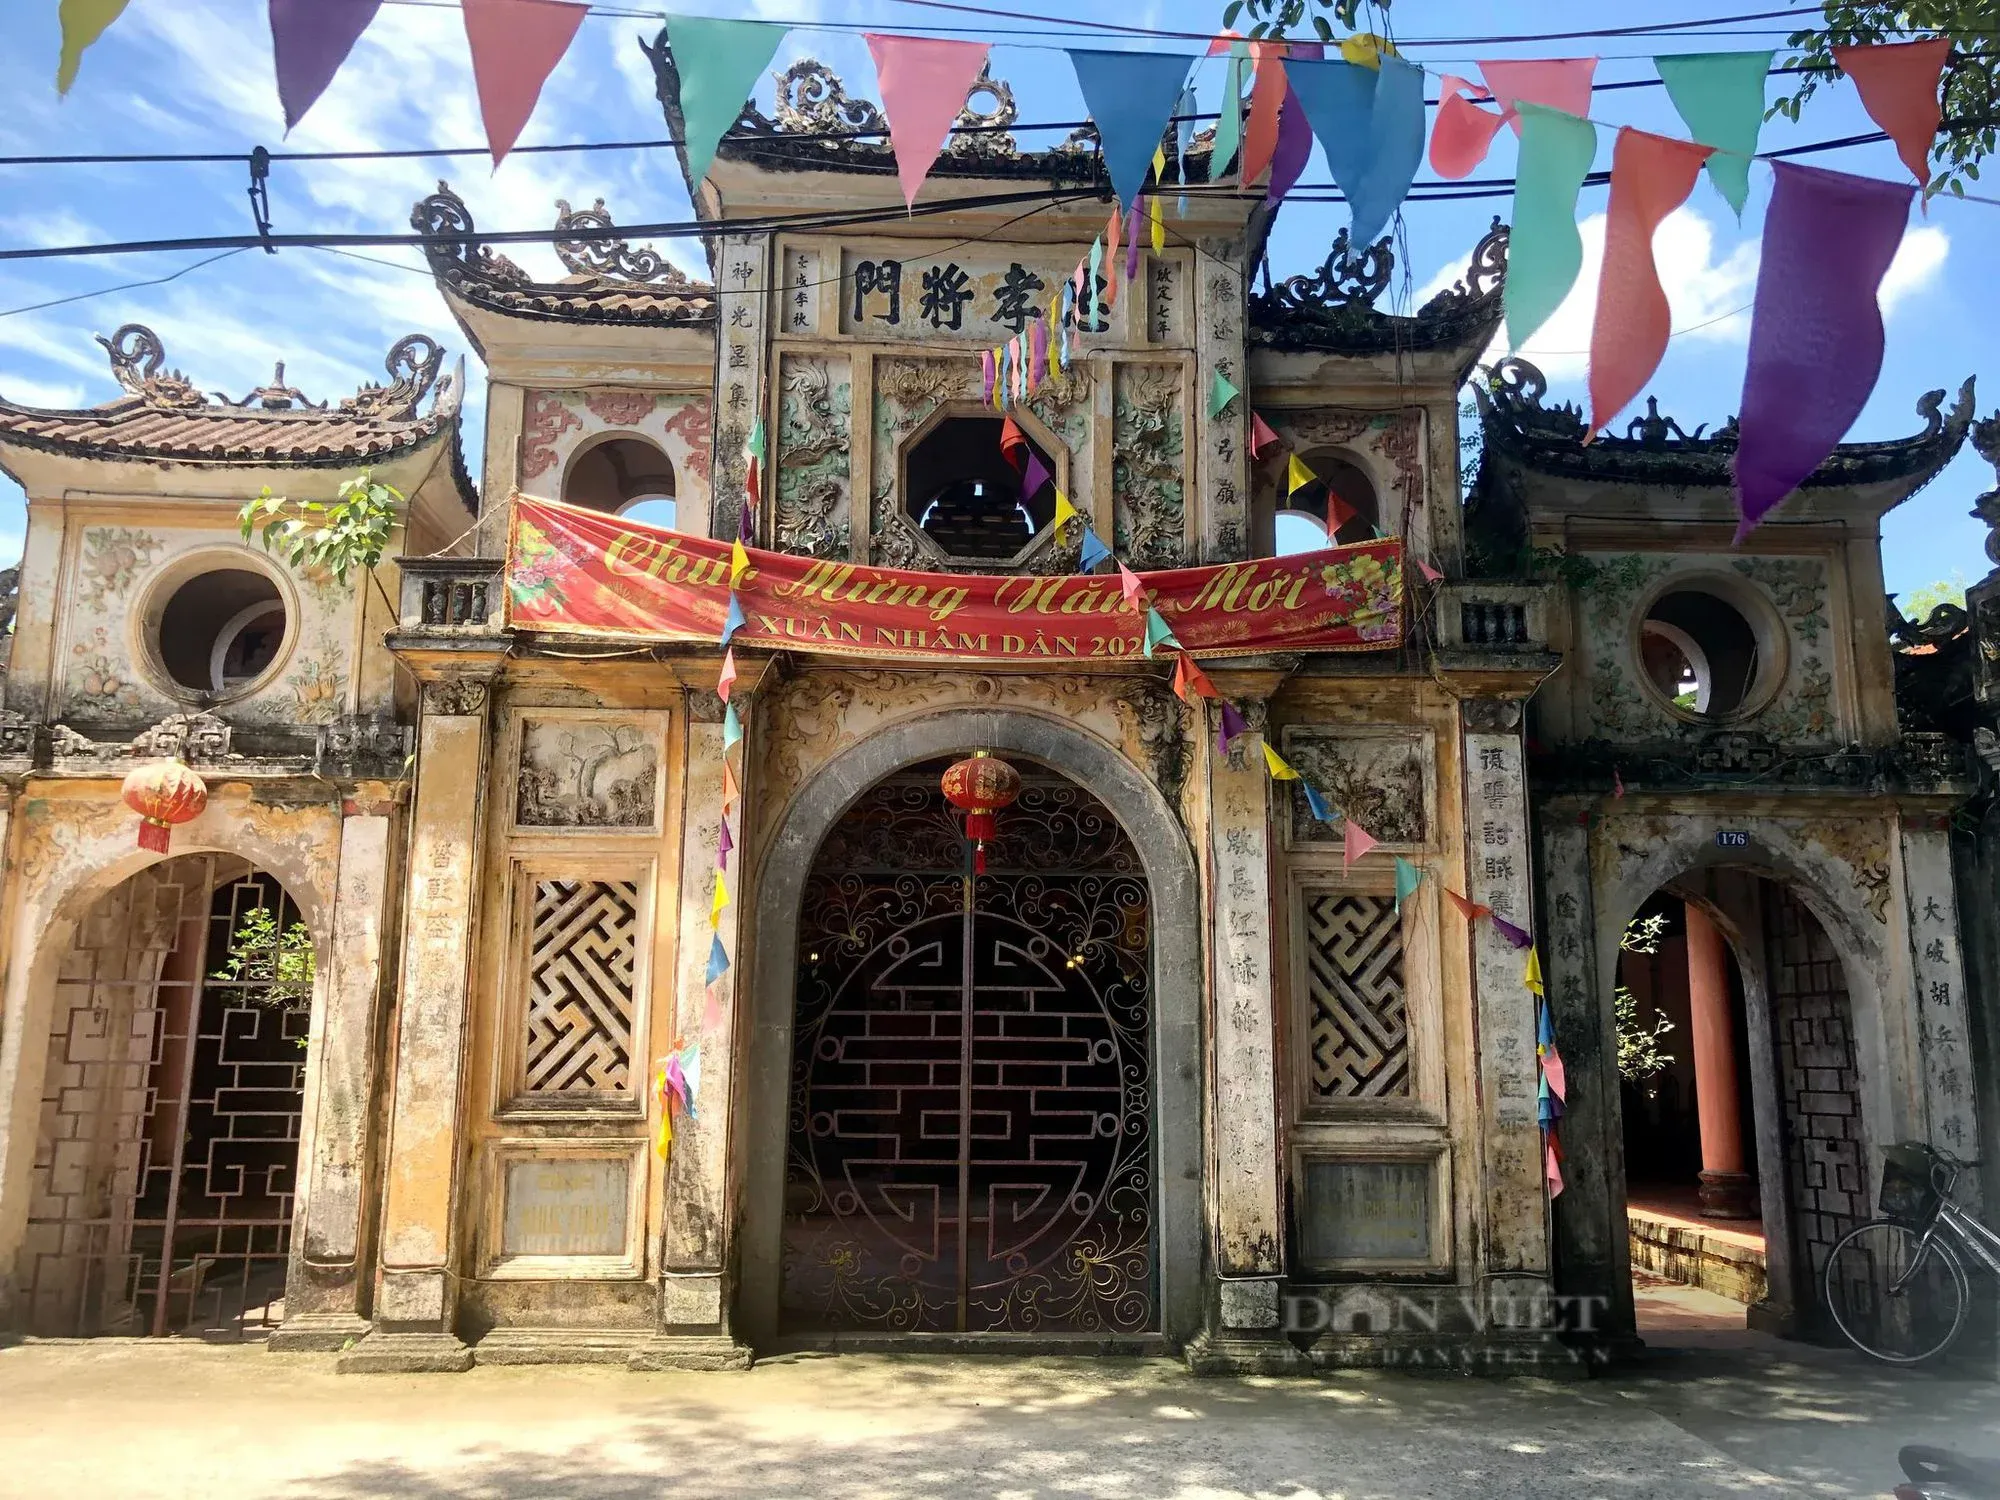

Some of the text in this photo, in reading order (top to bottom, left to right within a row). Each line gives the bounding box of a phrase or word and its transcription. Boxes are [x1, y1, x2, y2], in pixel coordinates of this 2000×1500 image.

[774, 560, 970, 621] Mừng
[1176, 564, 1310, 613] Mới
[756, 615, 1149, 657] XUÂN NHÂM DẦN 202
[1721, 833, 1746, 846] 176
